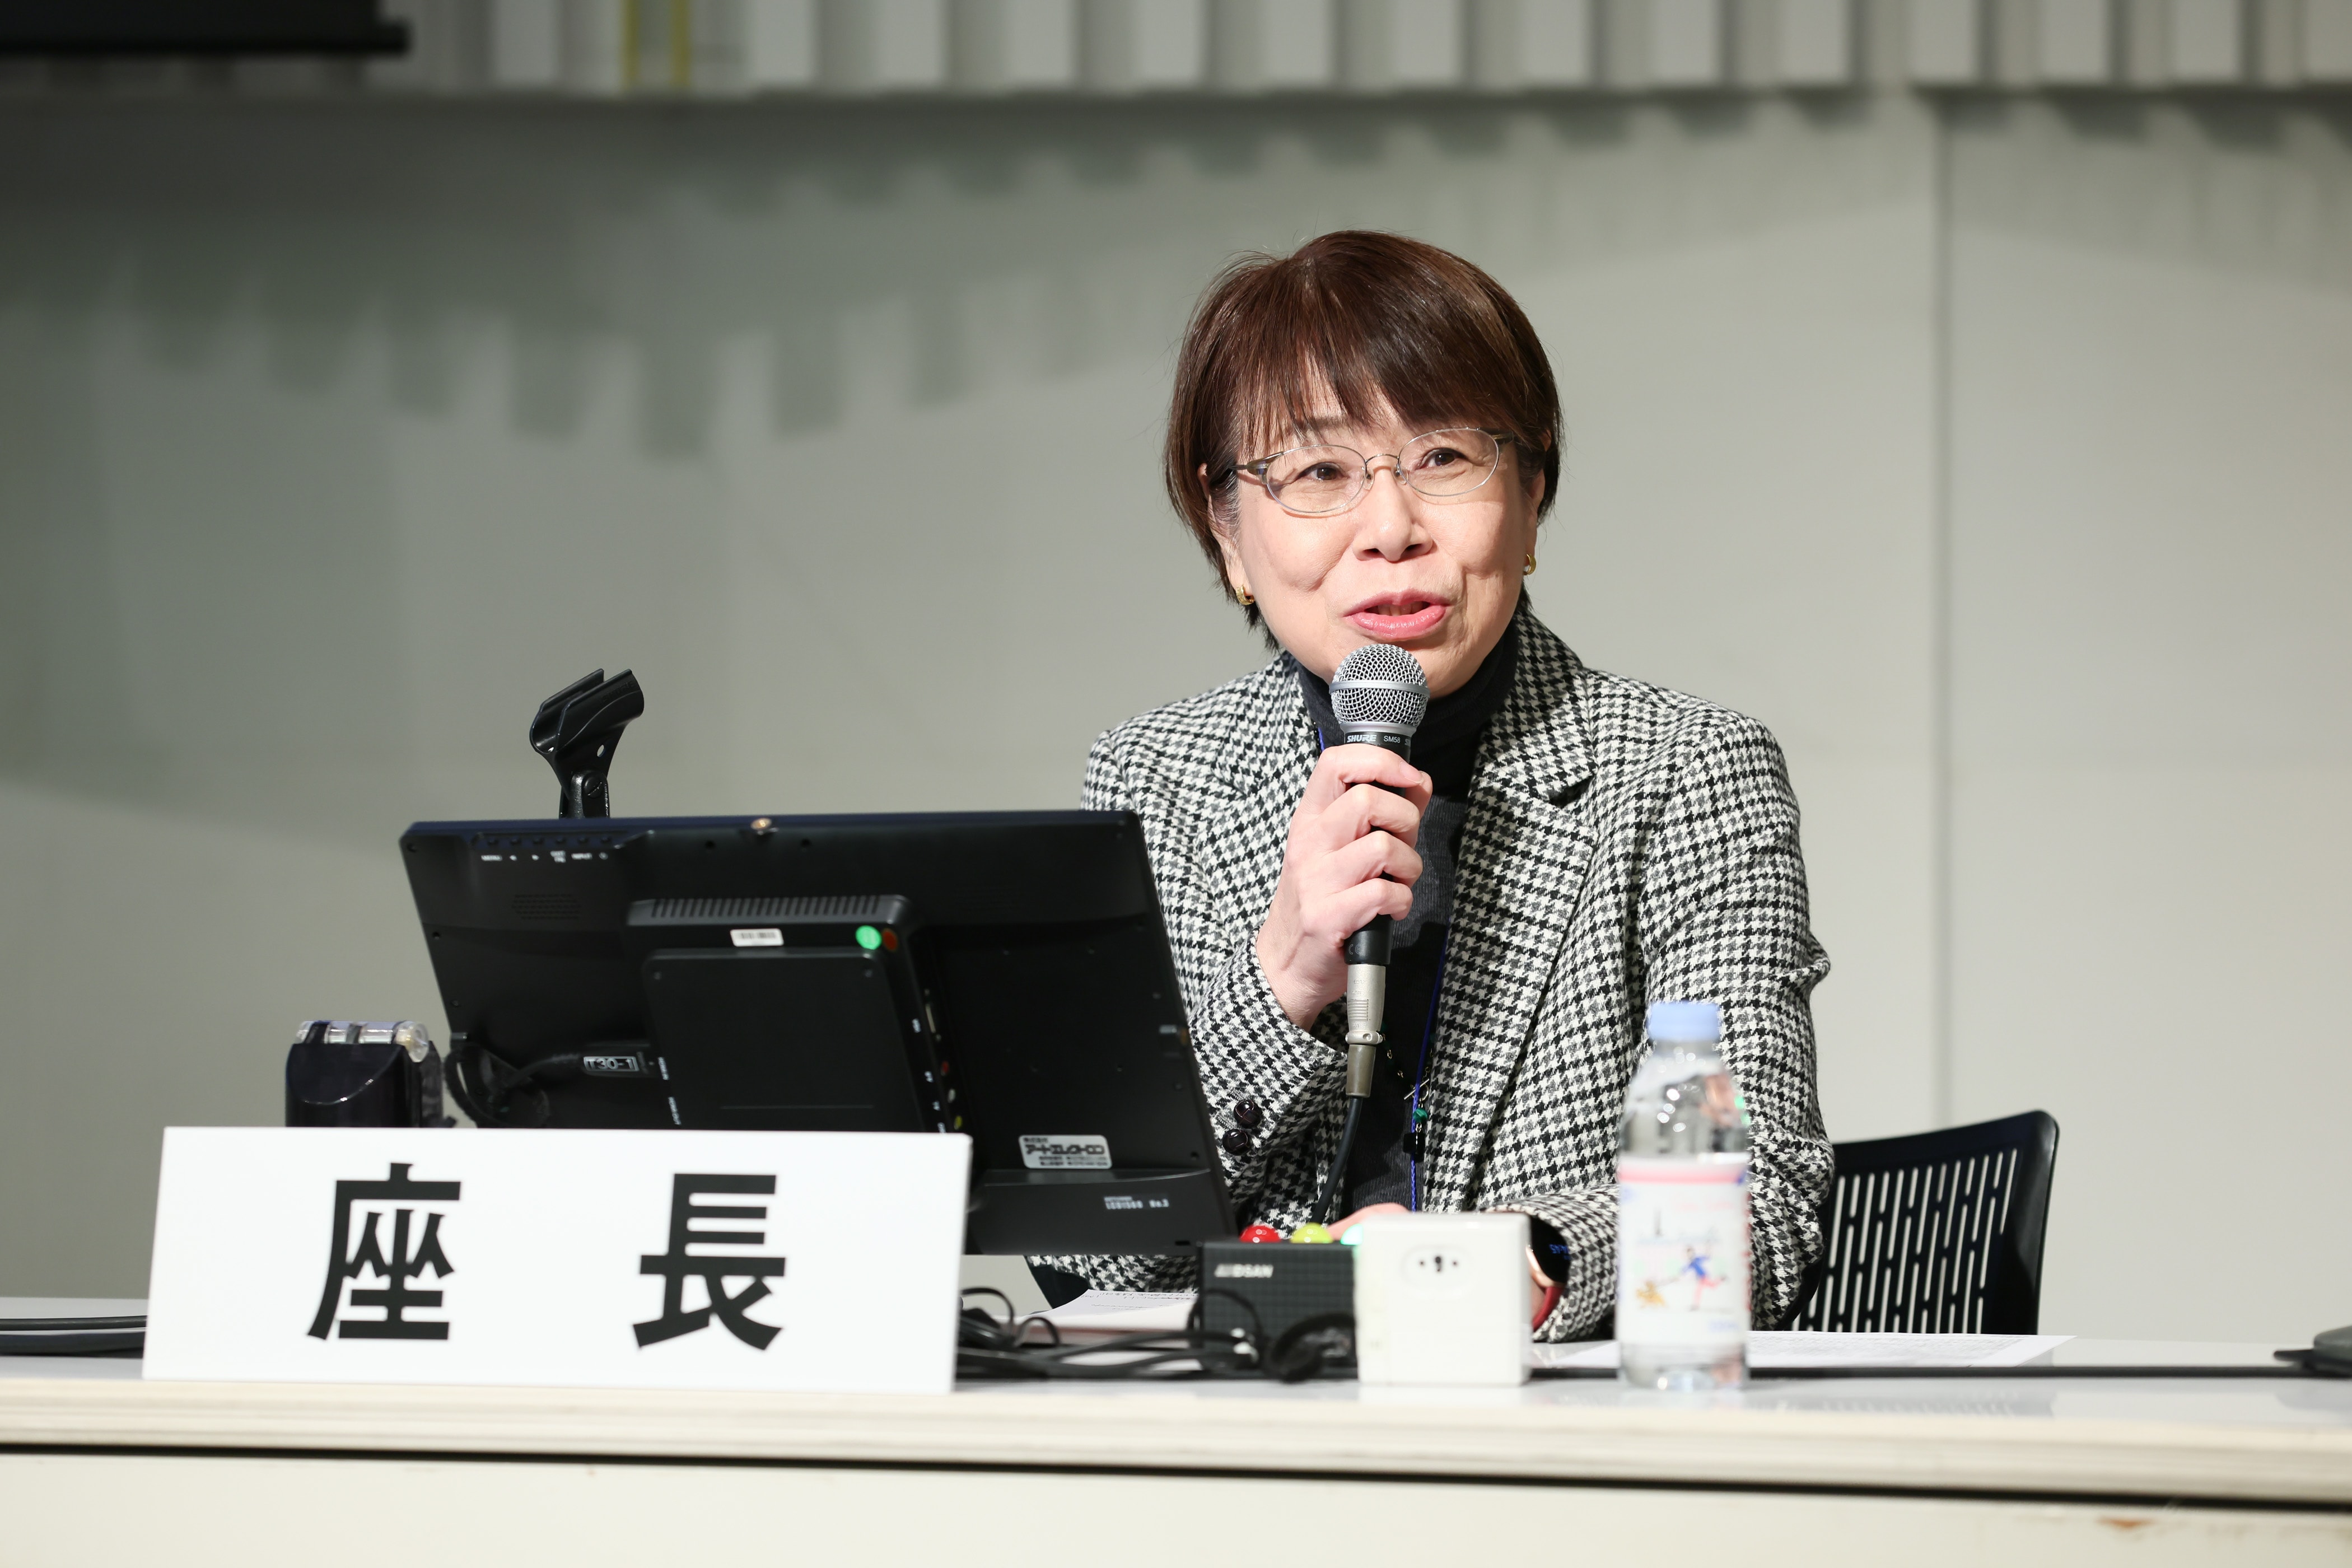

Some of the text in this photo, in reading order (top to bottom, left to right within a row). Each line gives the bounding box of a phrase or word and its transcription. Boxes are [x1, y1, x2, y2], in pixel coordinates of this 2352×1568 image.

[1347, 734, 1377, 743] SHURE
[586, 1057, 635, 1070] T30-1
[307, 1163, 785, 1350] 座長
